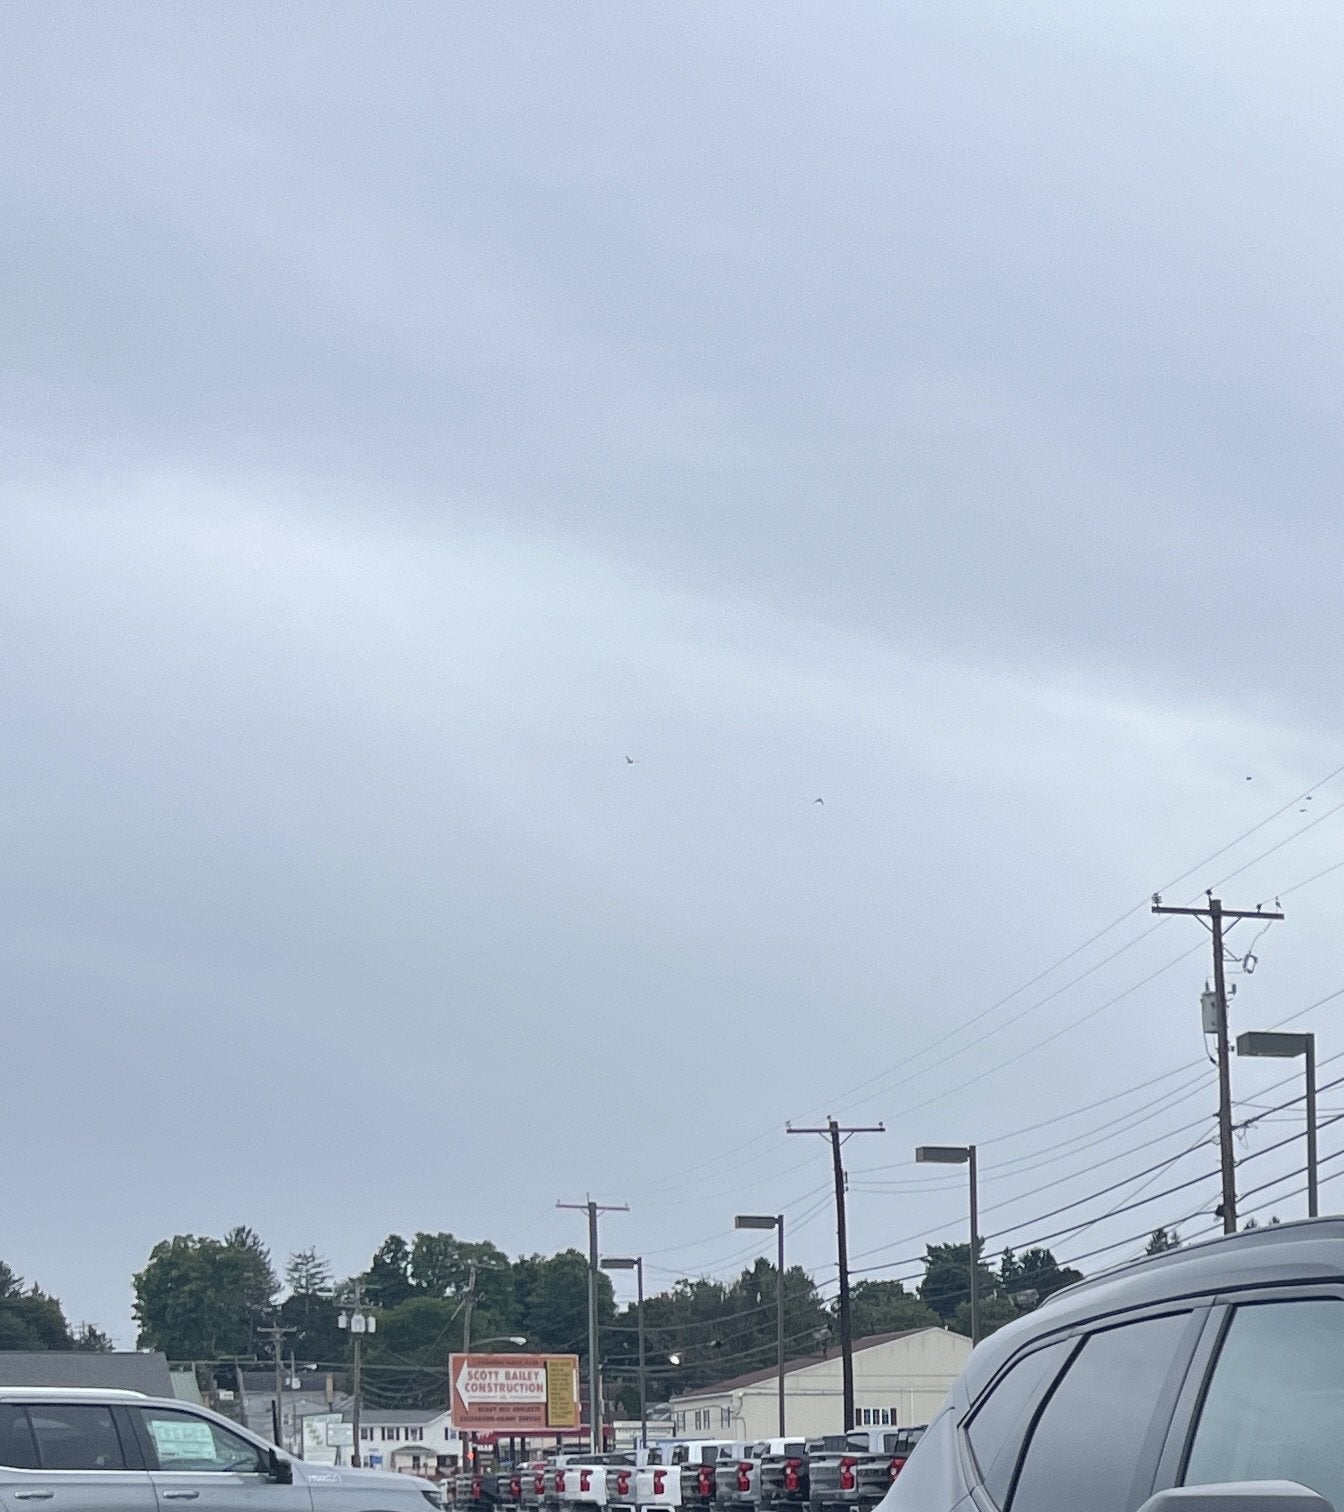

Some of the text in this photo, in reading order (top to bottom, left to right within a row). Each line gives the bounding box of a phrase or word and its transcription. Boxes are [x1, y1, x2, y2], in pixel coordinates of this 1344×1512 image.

[467, 1370, 539, 1381] SCOTT BAILEY
[464, 1382, 544, 1393] CONSTRUCTION
